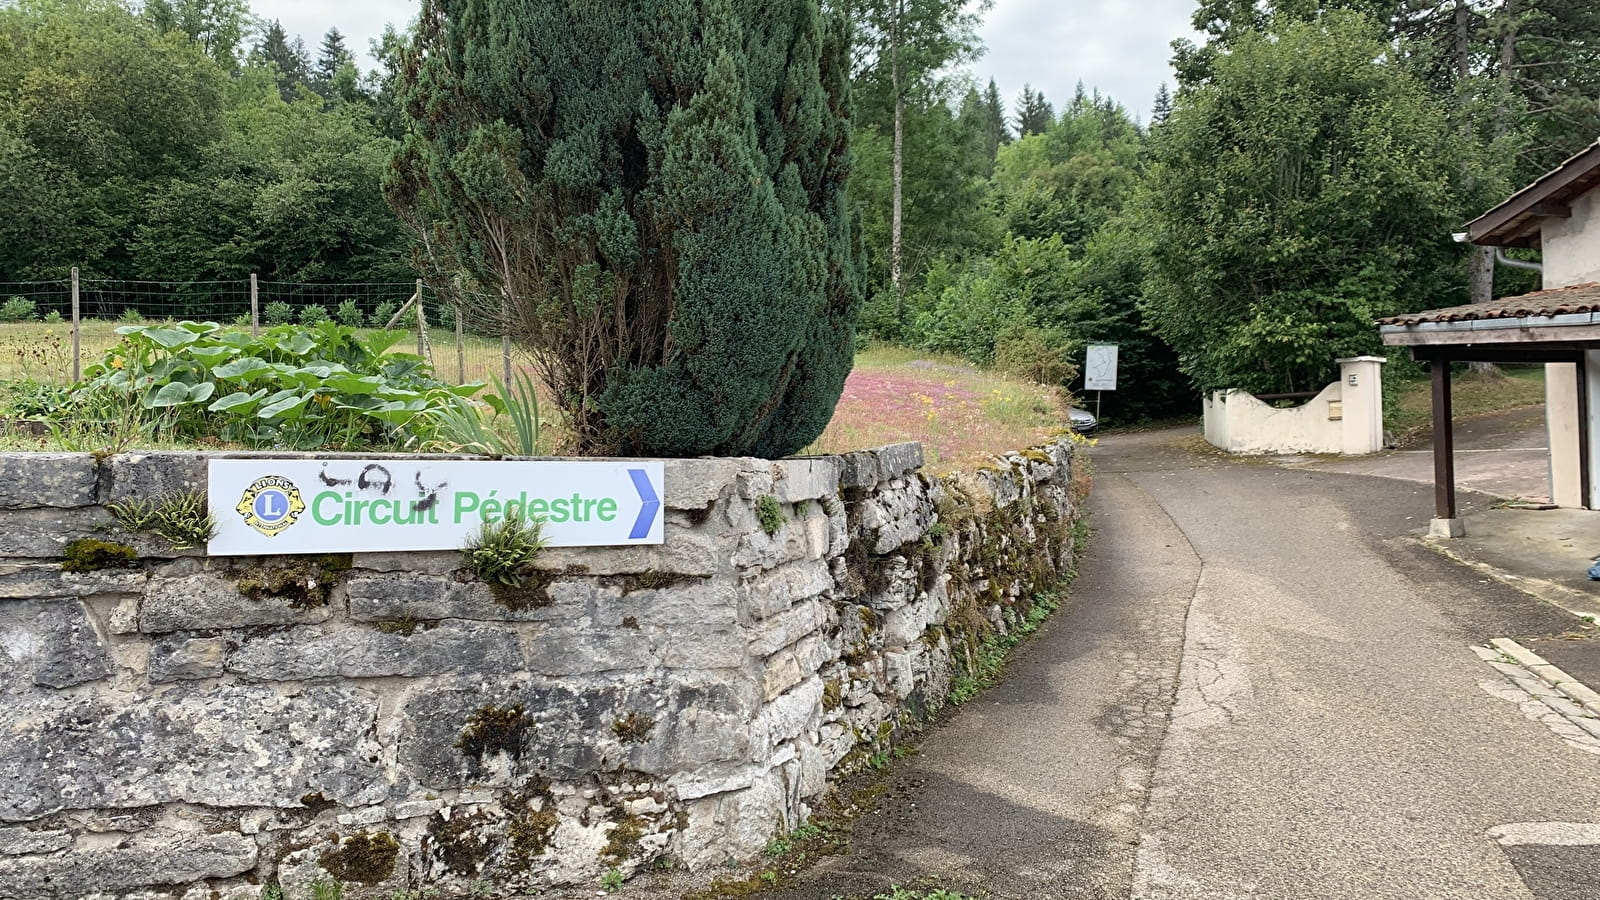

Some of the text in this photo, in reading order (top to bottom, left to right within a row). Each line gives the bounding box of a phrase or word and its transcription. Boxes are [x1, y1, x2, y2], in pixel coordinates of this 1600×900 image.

[254, 478, 290, 491] LIONS
[263, 494, 282, 517] L
[311, 489, 618, 526] Circuit Pédestre
